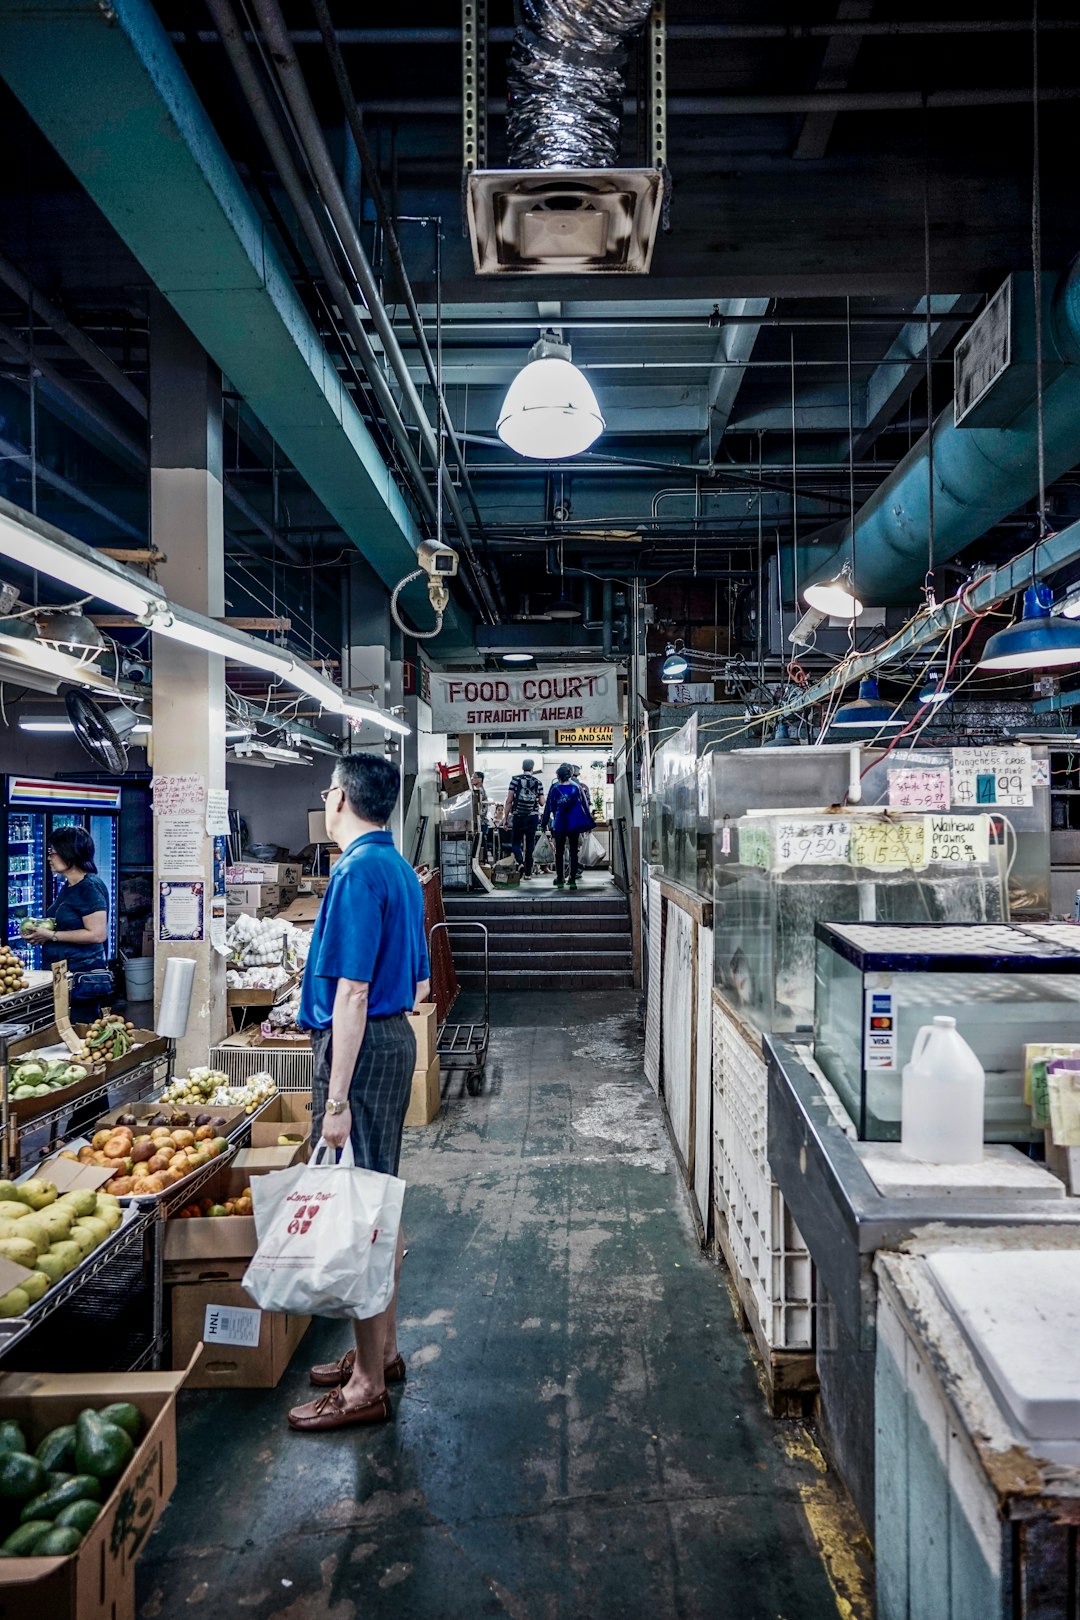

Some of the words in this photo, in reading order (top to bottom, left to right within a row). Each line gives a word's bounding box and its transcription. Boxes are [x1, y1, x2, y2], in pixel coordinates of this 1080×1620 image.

[449, 681, 509, 703] FOOD
[523, 675, 598, 699] COURT
[467, 709, 530, 724] STRAIGHT
[540, 706, 583, 721] AHEAD
[560, 734, 577, 742] PHO
[578, 734, 595, 742] AND
[596, 734, 613, 742] SAN
[973, 748, 998, 757] LIVE
[1010, 796, 1025, 805] LB
[208, 1311, 220, 1335] HNL
